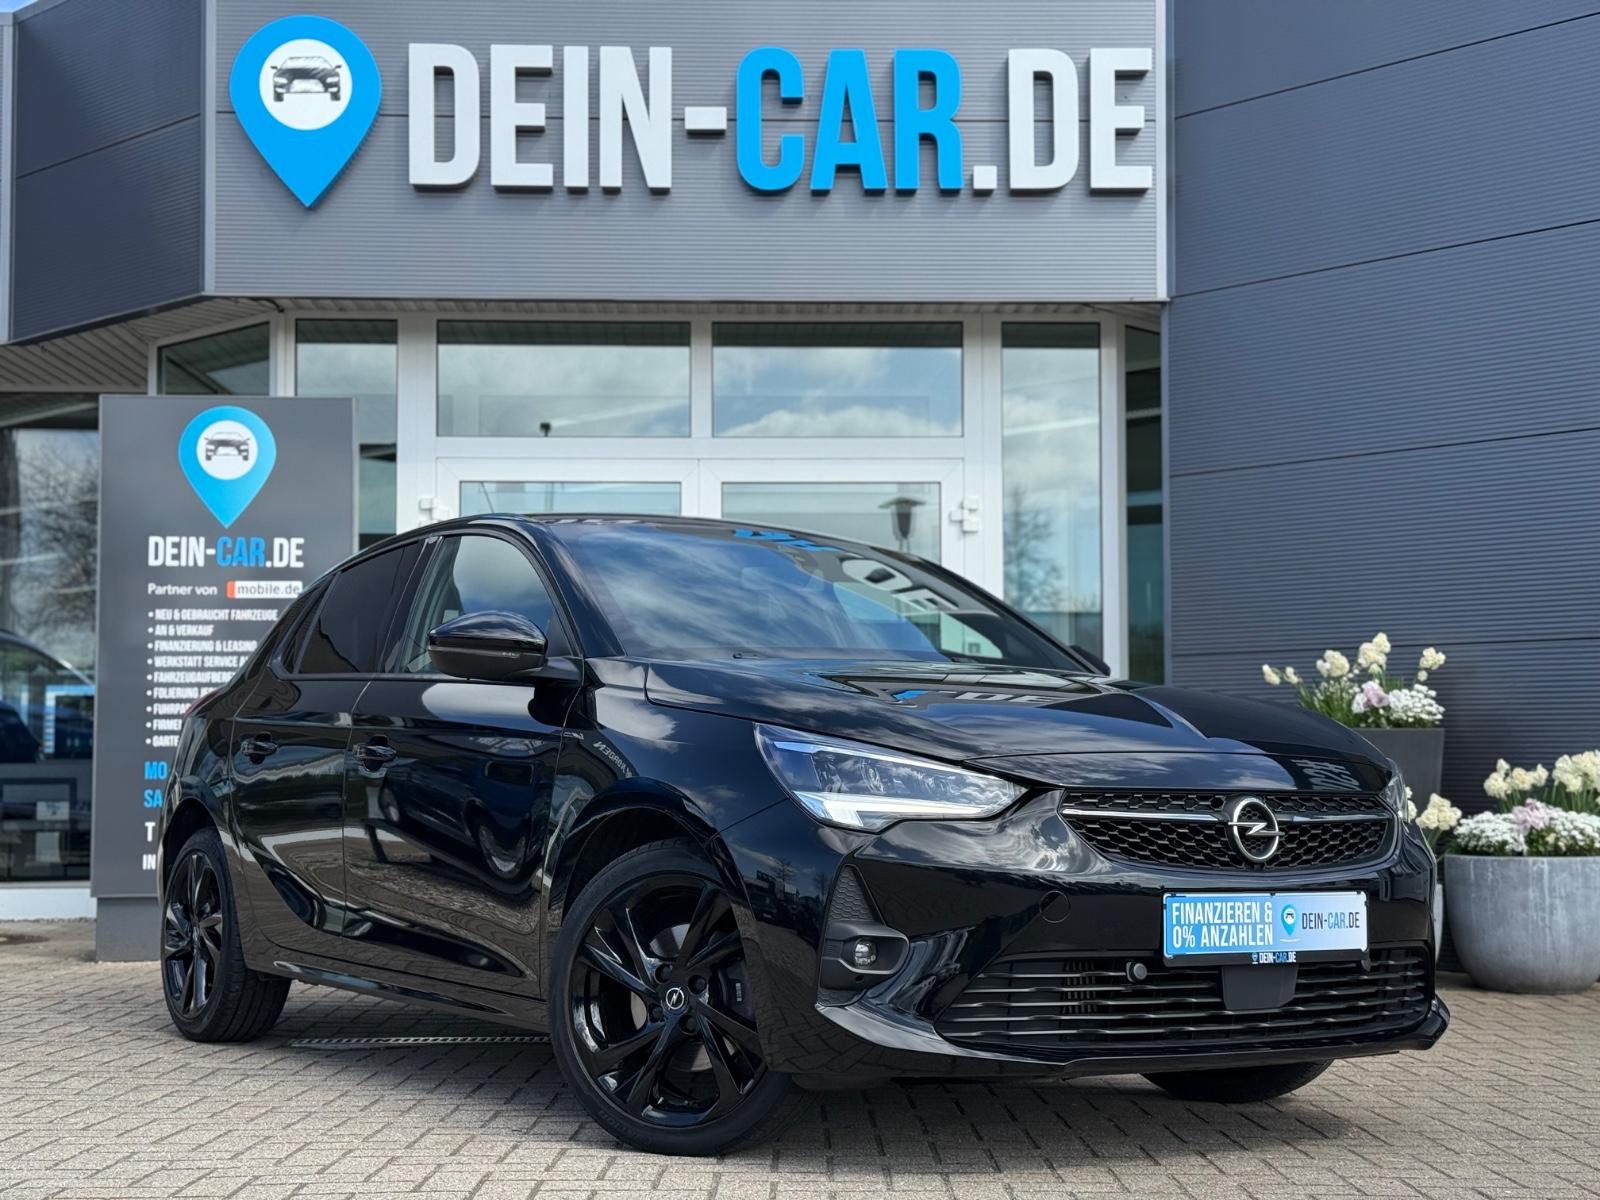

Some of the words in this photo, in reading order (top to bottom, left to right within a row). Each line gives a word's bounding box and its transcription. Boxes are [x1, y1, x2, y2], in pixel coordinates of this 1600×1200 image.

[408, 42, 1154, 194] DEIN-CAR.DE
[148, 536, 304, 568] DEIN-CAR.DE
[148, 582, 192, 596] Partner
[195, 585, 218, 596] von
[237, 583, 300, 595] mobile.de
[155, 608, 173, 621] NEU
[182, 609, 230, 621] GEBRAUCHT
[155, 624, 168, 636] AN
[176, 624, 214, 636] VERKAUF
[155, 640, 214, 652] FINANZIERUNG
[154, 656, 202, 667] WERKSTATT
[203, 656, 238, 667] SERVICE
[153, 687, 199, 699] FOLIERUNG
[144, 789, 163, 808] SA
[1172, 901, 1261, 925] FINANZIEREN
[1264, 901, 1273, 922] &
[1302, 912, 1360, 930] DEIN-CAR.DE
[1172, 926, 1195, 948] 0%
[1201, 924, 1274, 947] ANZAHLEN
[1259, 952, 1297, 964] DEIN-CAR.DE
